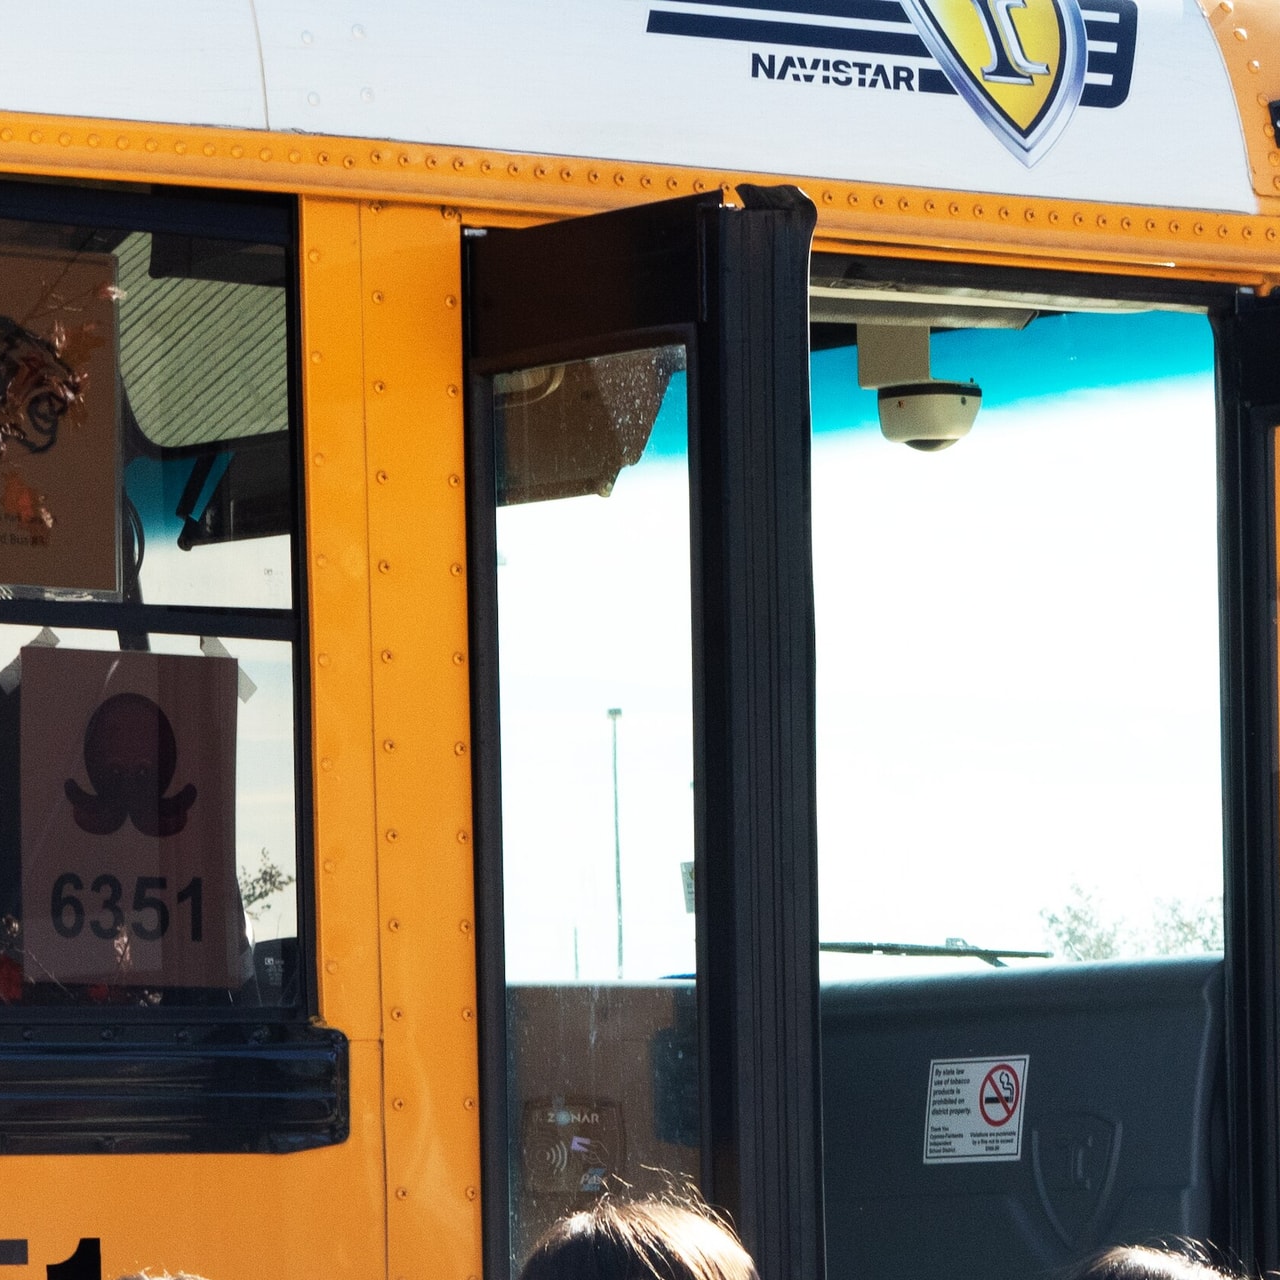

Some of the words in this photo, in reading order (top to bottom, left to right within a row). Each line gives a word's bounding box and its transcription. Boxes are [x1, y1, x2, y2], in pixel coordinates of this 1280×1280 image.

[751, 52, 915, 92] NAVISTAR
[51, 873, 202, 942] 6351
[935, 1068, 940, 1076] By
[933, 1088, 955, 1096] products
[932, 1098, 957, 1106] prohibited
